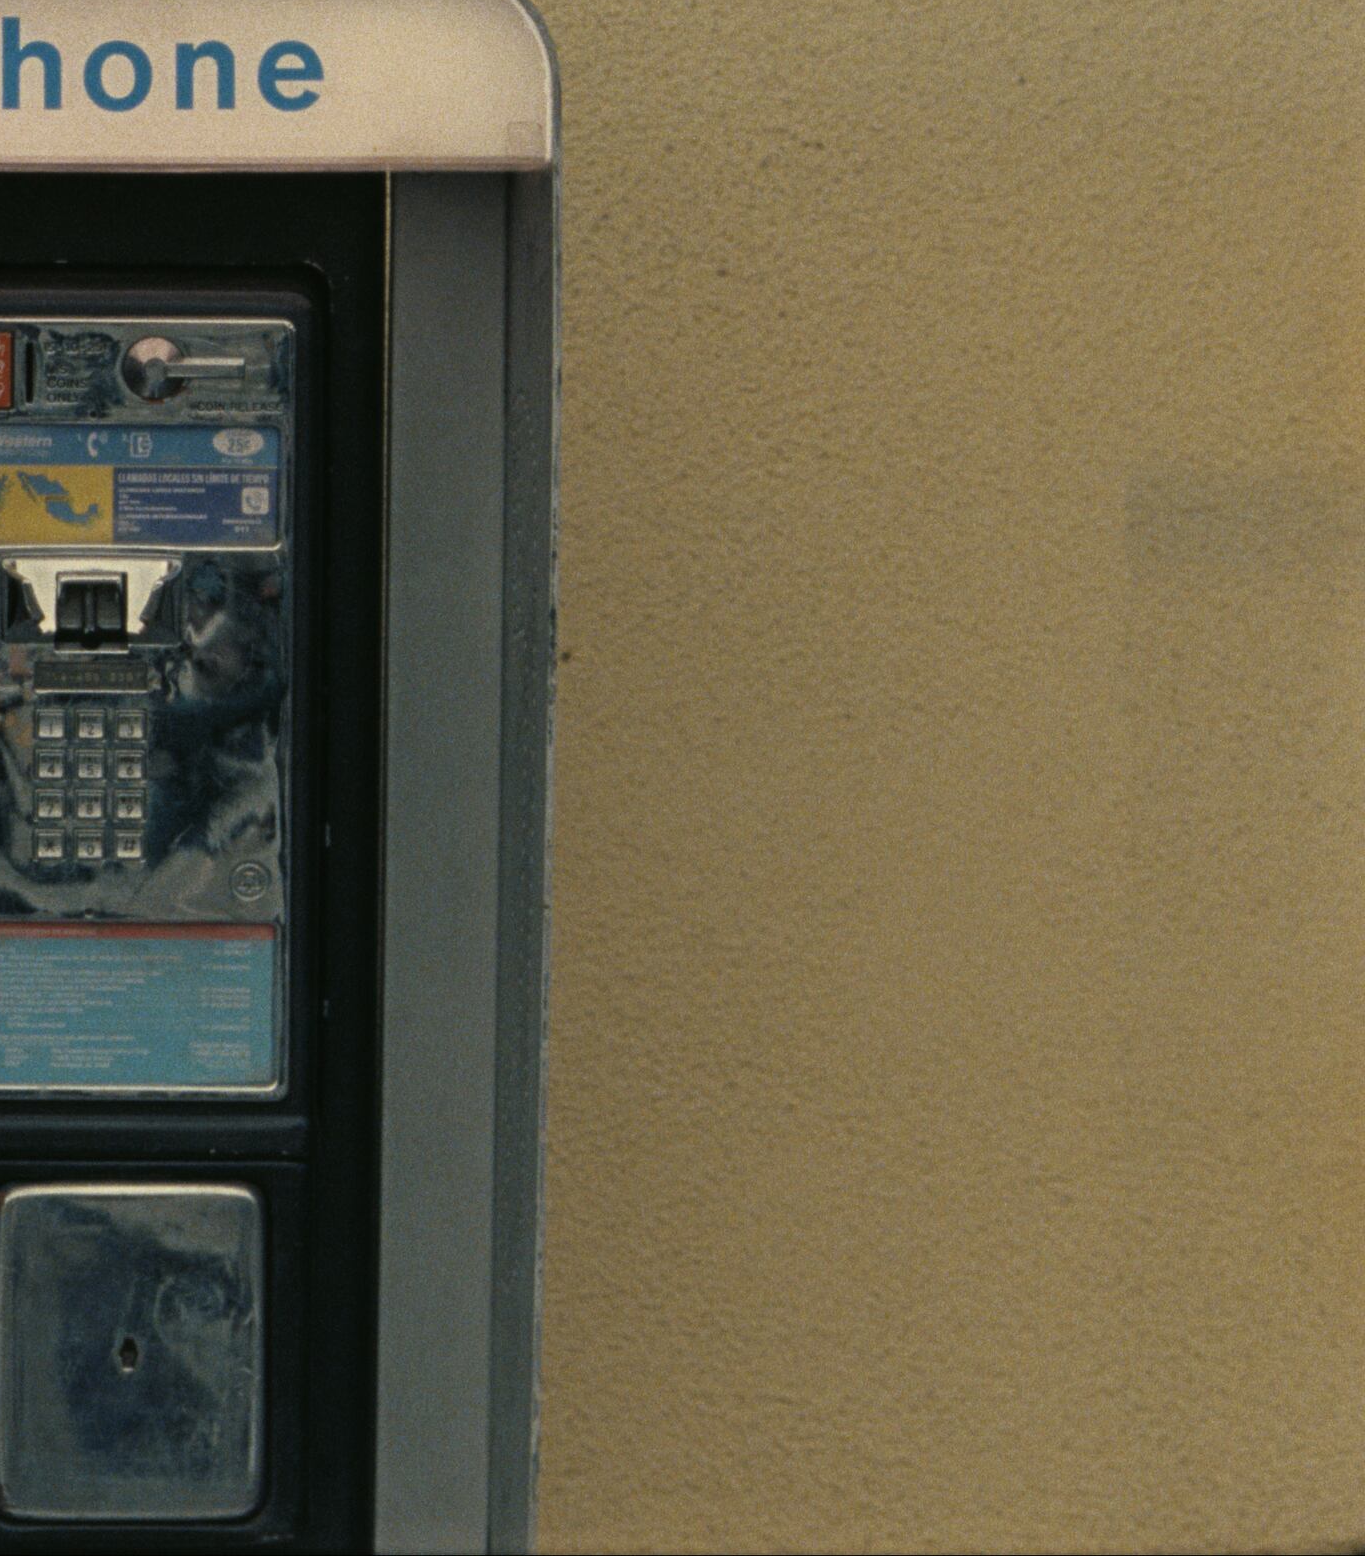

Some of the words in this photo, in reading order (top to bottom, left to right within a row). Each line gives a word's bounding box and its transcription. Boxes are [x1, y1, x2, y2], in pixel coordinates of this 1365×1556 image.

[46, 376, 88, 390] COINS
[197, 401, 226, 412] COIN
[87, 724, 95, 736] 2
[47, 763, 55, 775] 4
[87, 764, 95, 776] 5
[126, 764, 135, 776] 6
[47, 803, 55, 815] 7
[86, 804, 94, 816] 8
[125, 804, 134, 815] 9
[86, 843, 96, 856] 0
